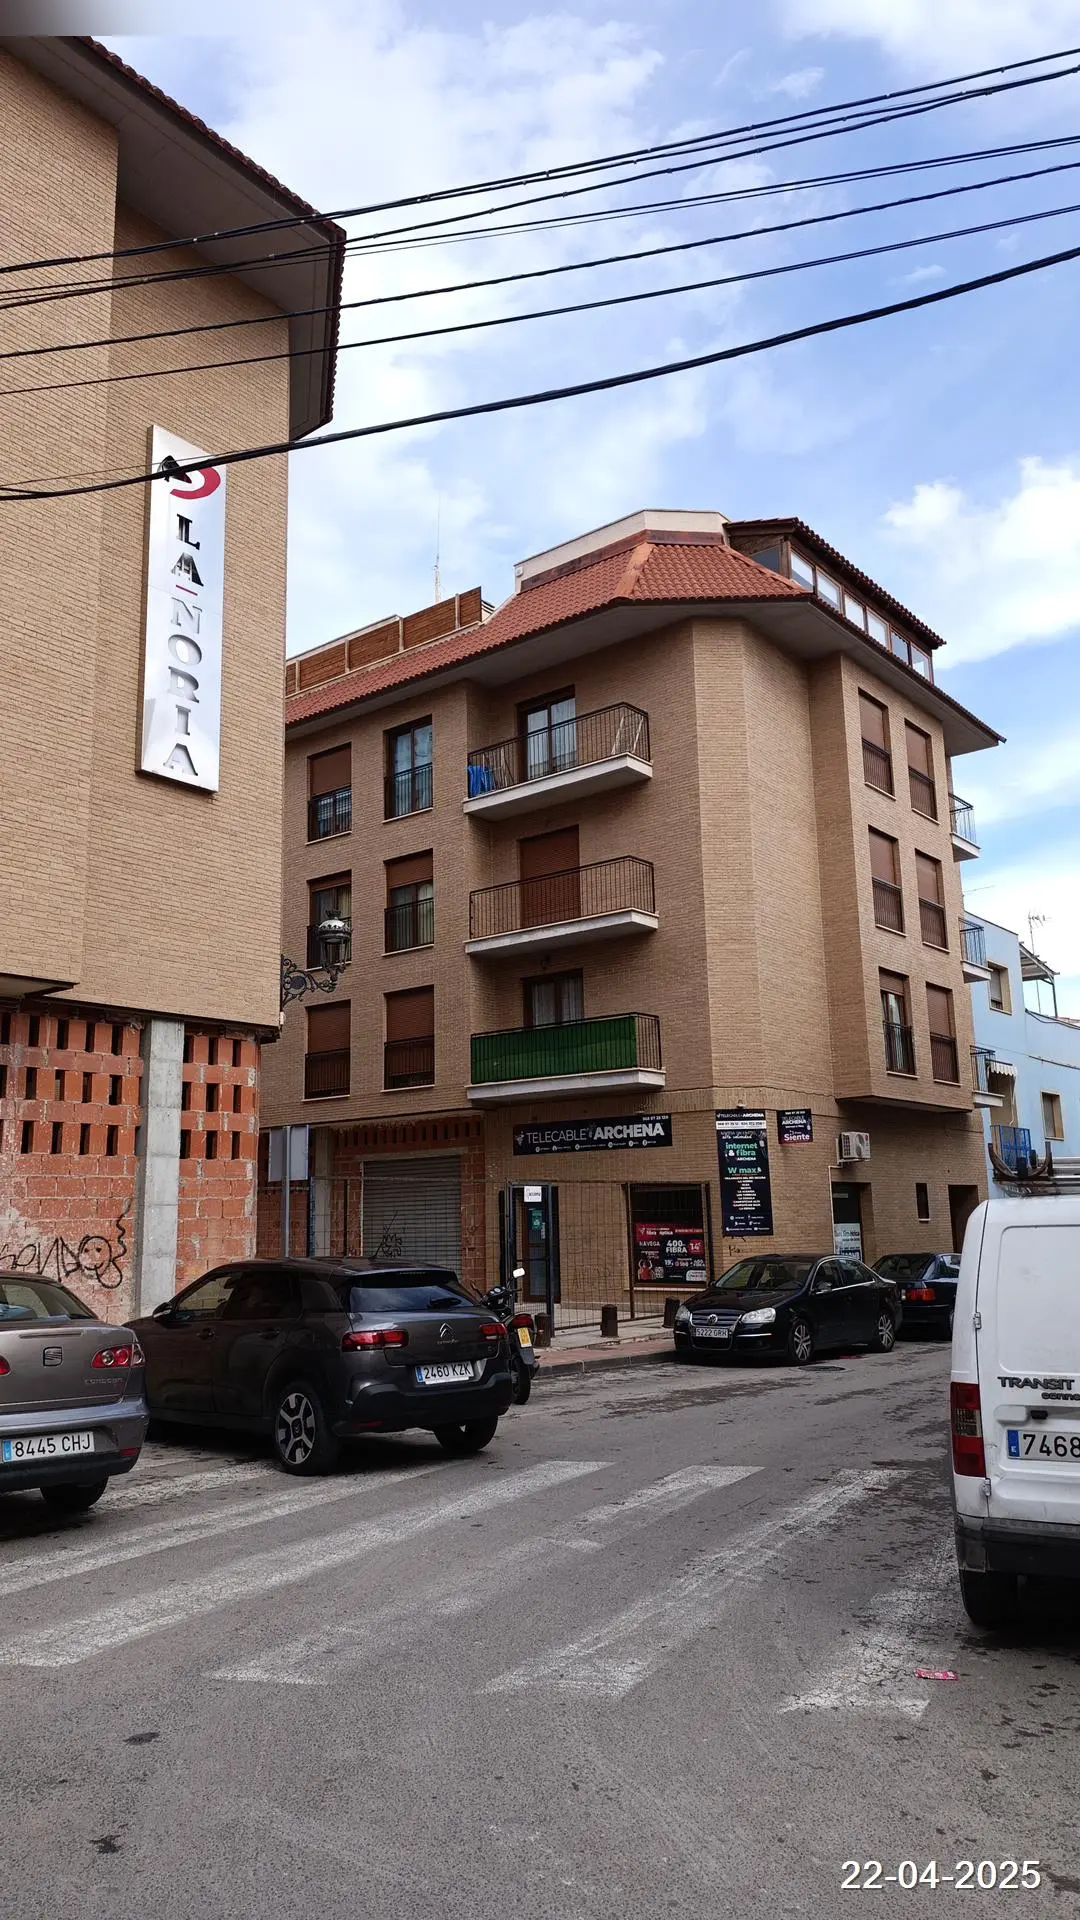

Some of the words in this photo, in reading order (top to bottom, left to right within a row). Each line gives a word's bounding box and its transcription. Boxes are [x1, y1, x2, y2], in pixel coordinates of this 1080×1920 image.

[163, 596, 203, 777] NORIA
[526, 1127, 588, 1144] TELECABLE
[593, 1121, 665, 1140] ARCHENA
[784, 1133, 810, 1141] Siente
[728, 1149, 735, 1157] &
[736, 1149, 757, 1157] fibra
[665, 1246, 688, 1254] FIBRA
[423, 1365, 450, 1379] 2460
[451, 1362, 472, 1376] KZK
[997, 1376, 1075, 1391] TRANSIT
[15, 1437, 56, 1457] 8445
[61, 1433, 91, 1452] CHJ
[1022, 1433, 1080, 1458] 7468
